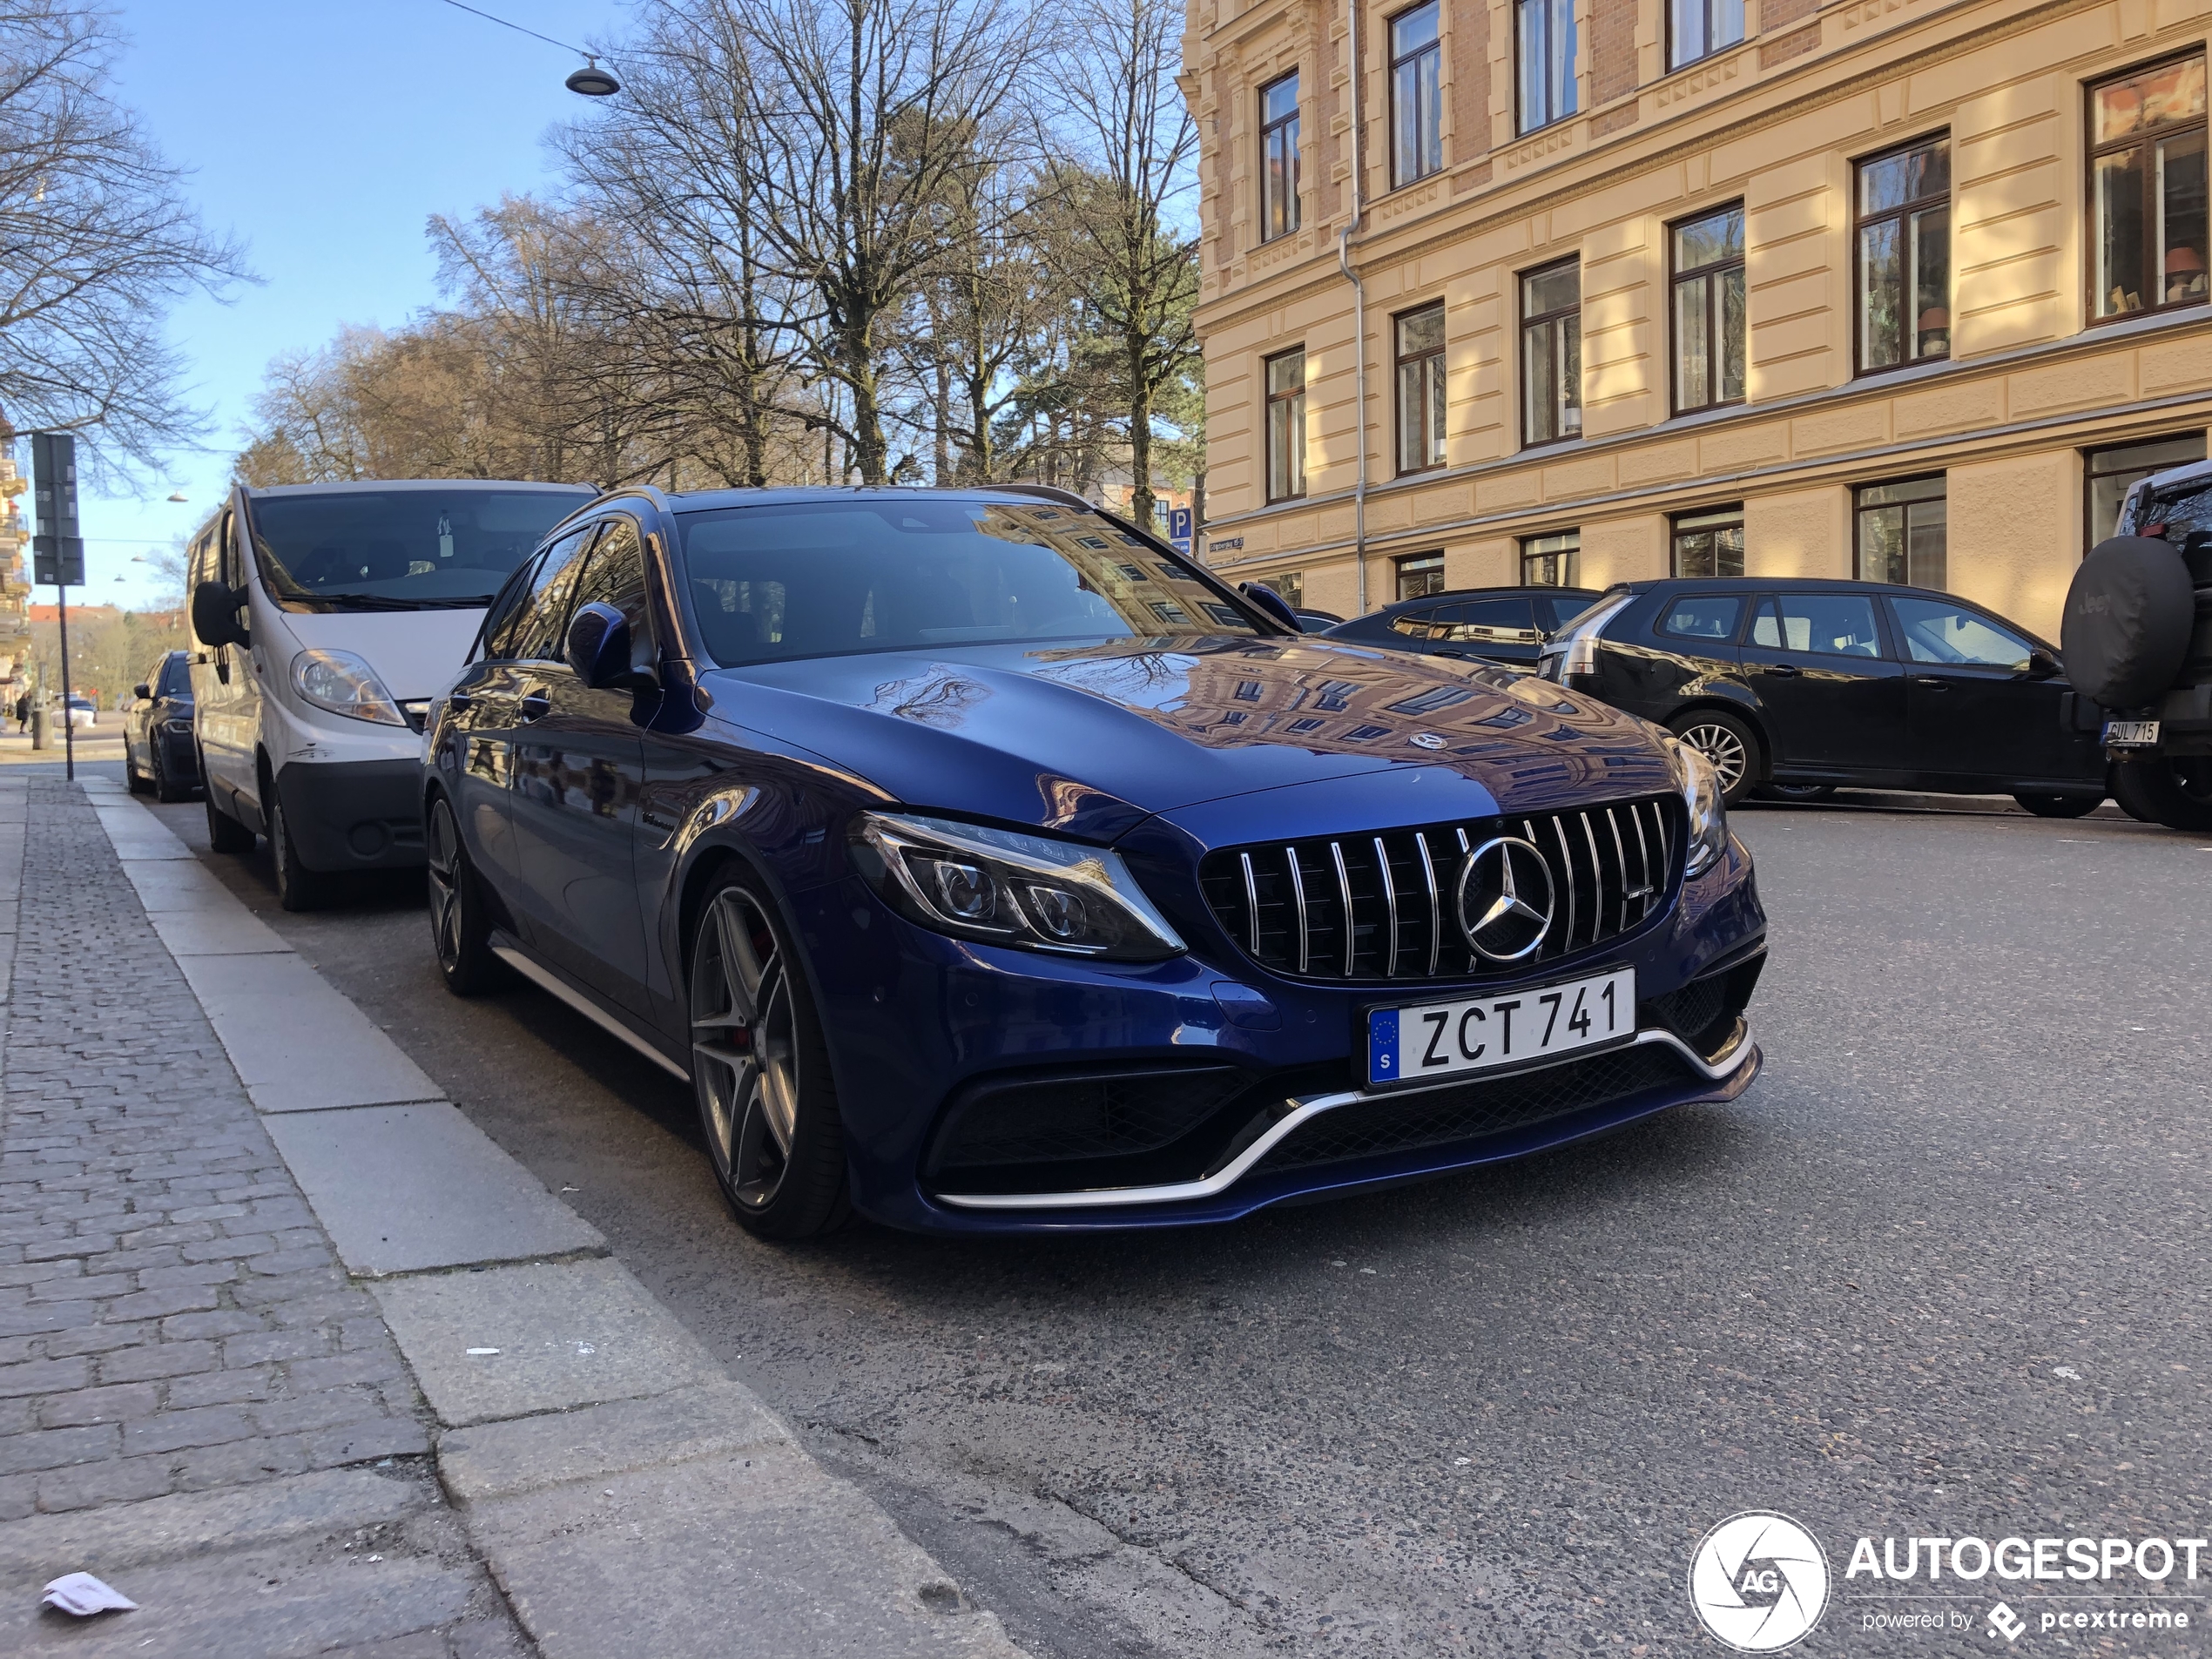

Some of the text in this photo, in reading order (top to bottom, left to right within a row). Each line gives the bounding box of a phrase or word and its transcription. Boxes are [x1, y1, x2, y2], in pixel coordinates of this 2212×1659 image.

[1176, 511, 1187, 536] P
[2078, 591, 2111, 616] Jeep
[2133, 723, 2155, 740] 715
[1421, 980, 1615, 1068] ZCT 741
[1380, 1054, 1391, 1069] S
